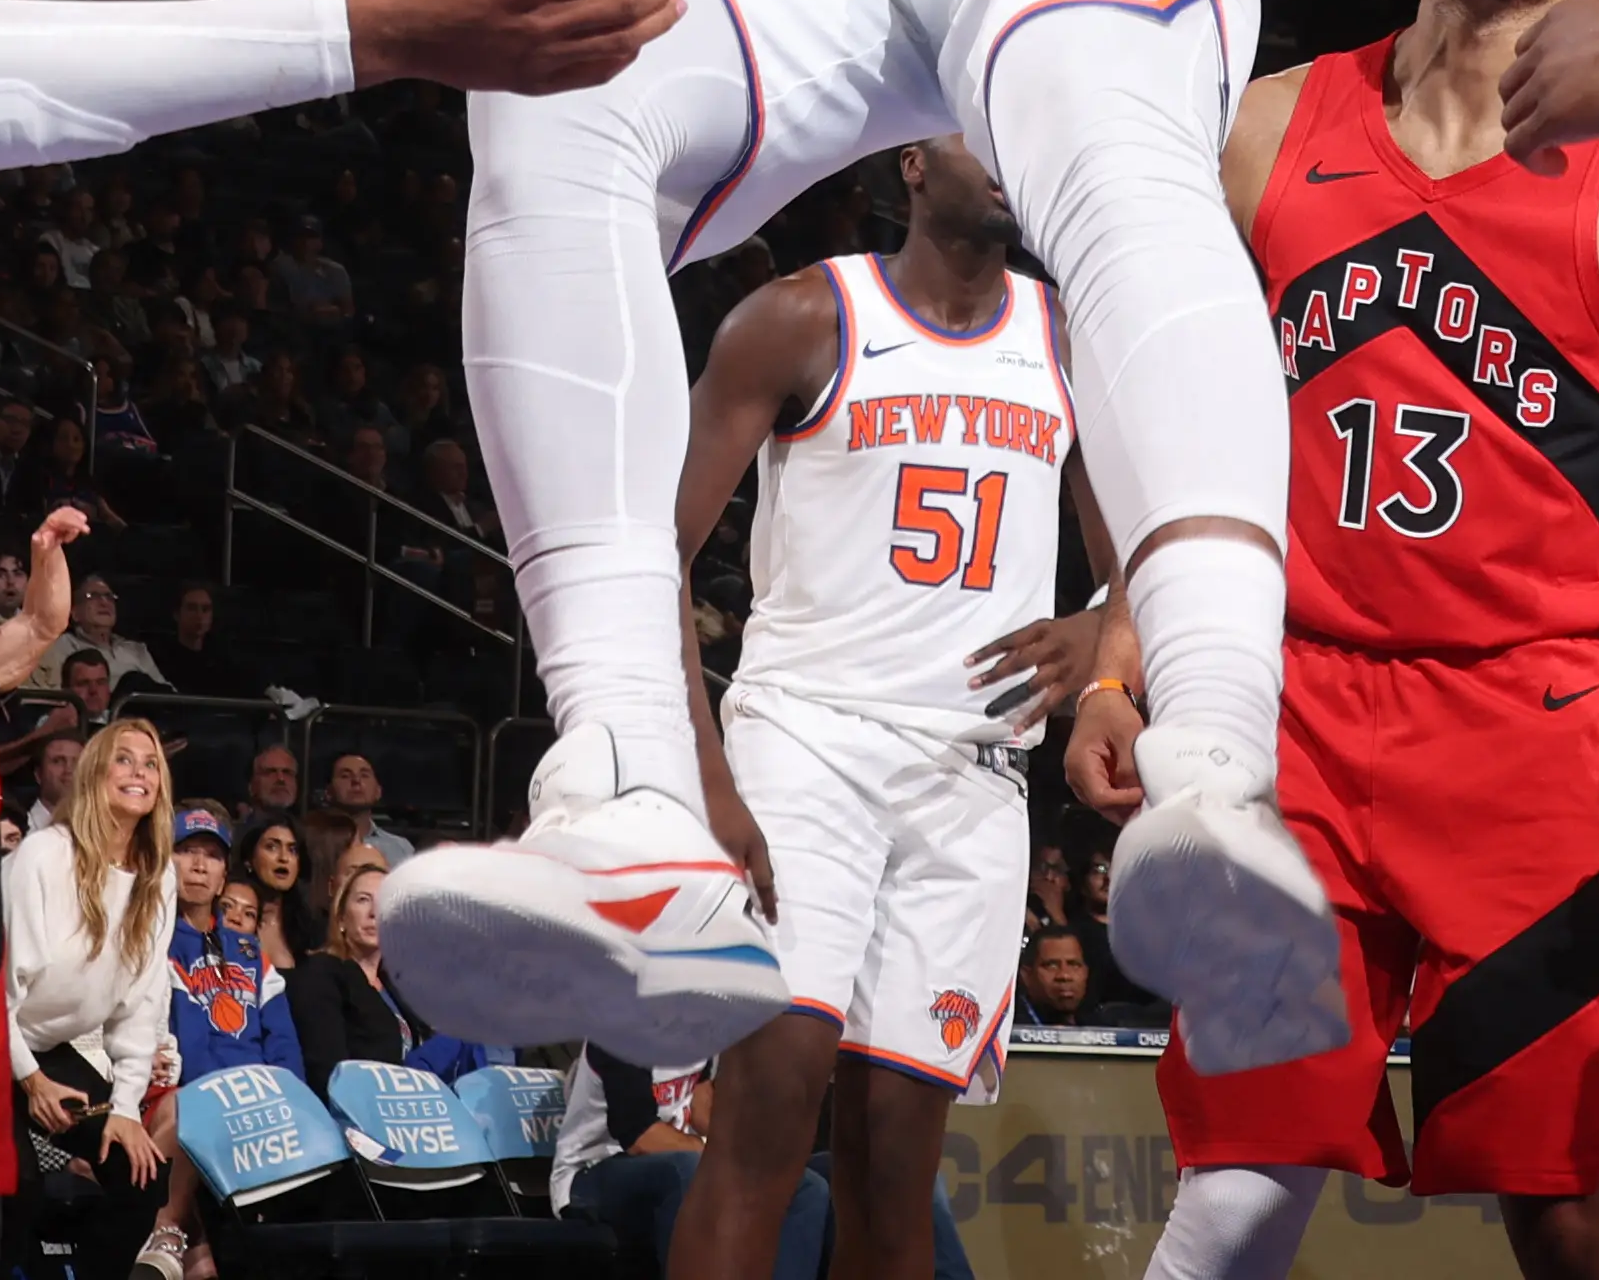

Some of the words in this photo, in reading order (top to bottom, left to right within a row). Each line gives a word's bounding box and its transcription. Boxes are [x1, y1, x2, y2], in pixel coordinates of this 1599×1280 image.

[1281, 247, 1558, 428] RAPTORS
[848, 394, 951, 453] NEW
[954, 394, 1062, 467] YORK
[1326, 398, 1470, 539] 13
[889, 462, 1010, 592] 51
[1019, 1028, 1060, 1044] CHASE
[1080, 1030, 1118, 1046] CHASE
[198, 1067, 283, 1110] TEN
[359, 1064, 442, 1093] TEN
[225, 1104, 293, 1136] LISTED
[376, 1101, 449, 1118] LISTED
[232, 1128, 304, 1175] NYSE
[384, 1124, 460, 1155] NYSE
